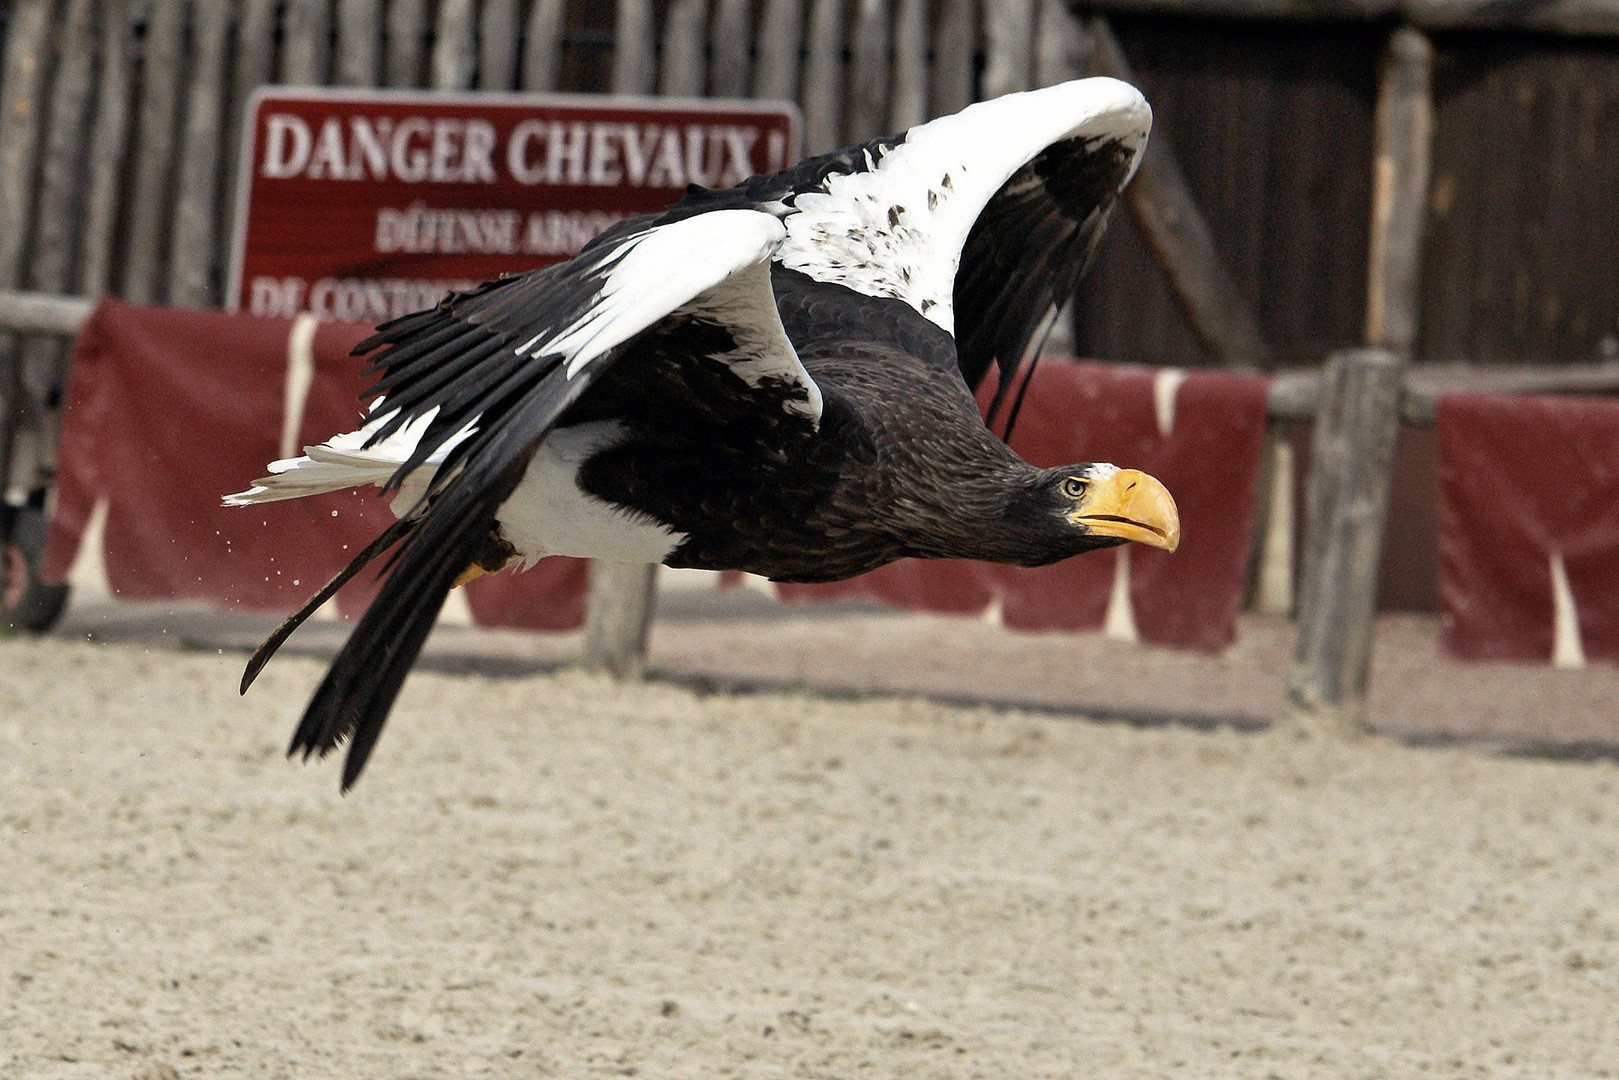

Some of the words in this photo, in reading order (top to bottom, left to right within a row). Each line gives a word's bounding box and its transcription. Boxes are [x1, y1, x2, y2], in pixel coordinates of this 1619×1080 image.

[263, 113, 497, 184] DANGER
[507, 118, 757, 188] CHEVAUX
[374, 200, 521, 253] DÉFENSE
[524, 209, 624, 254] ABSO
[252, 277, 305, 320] DE
